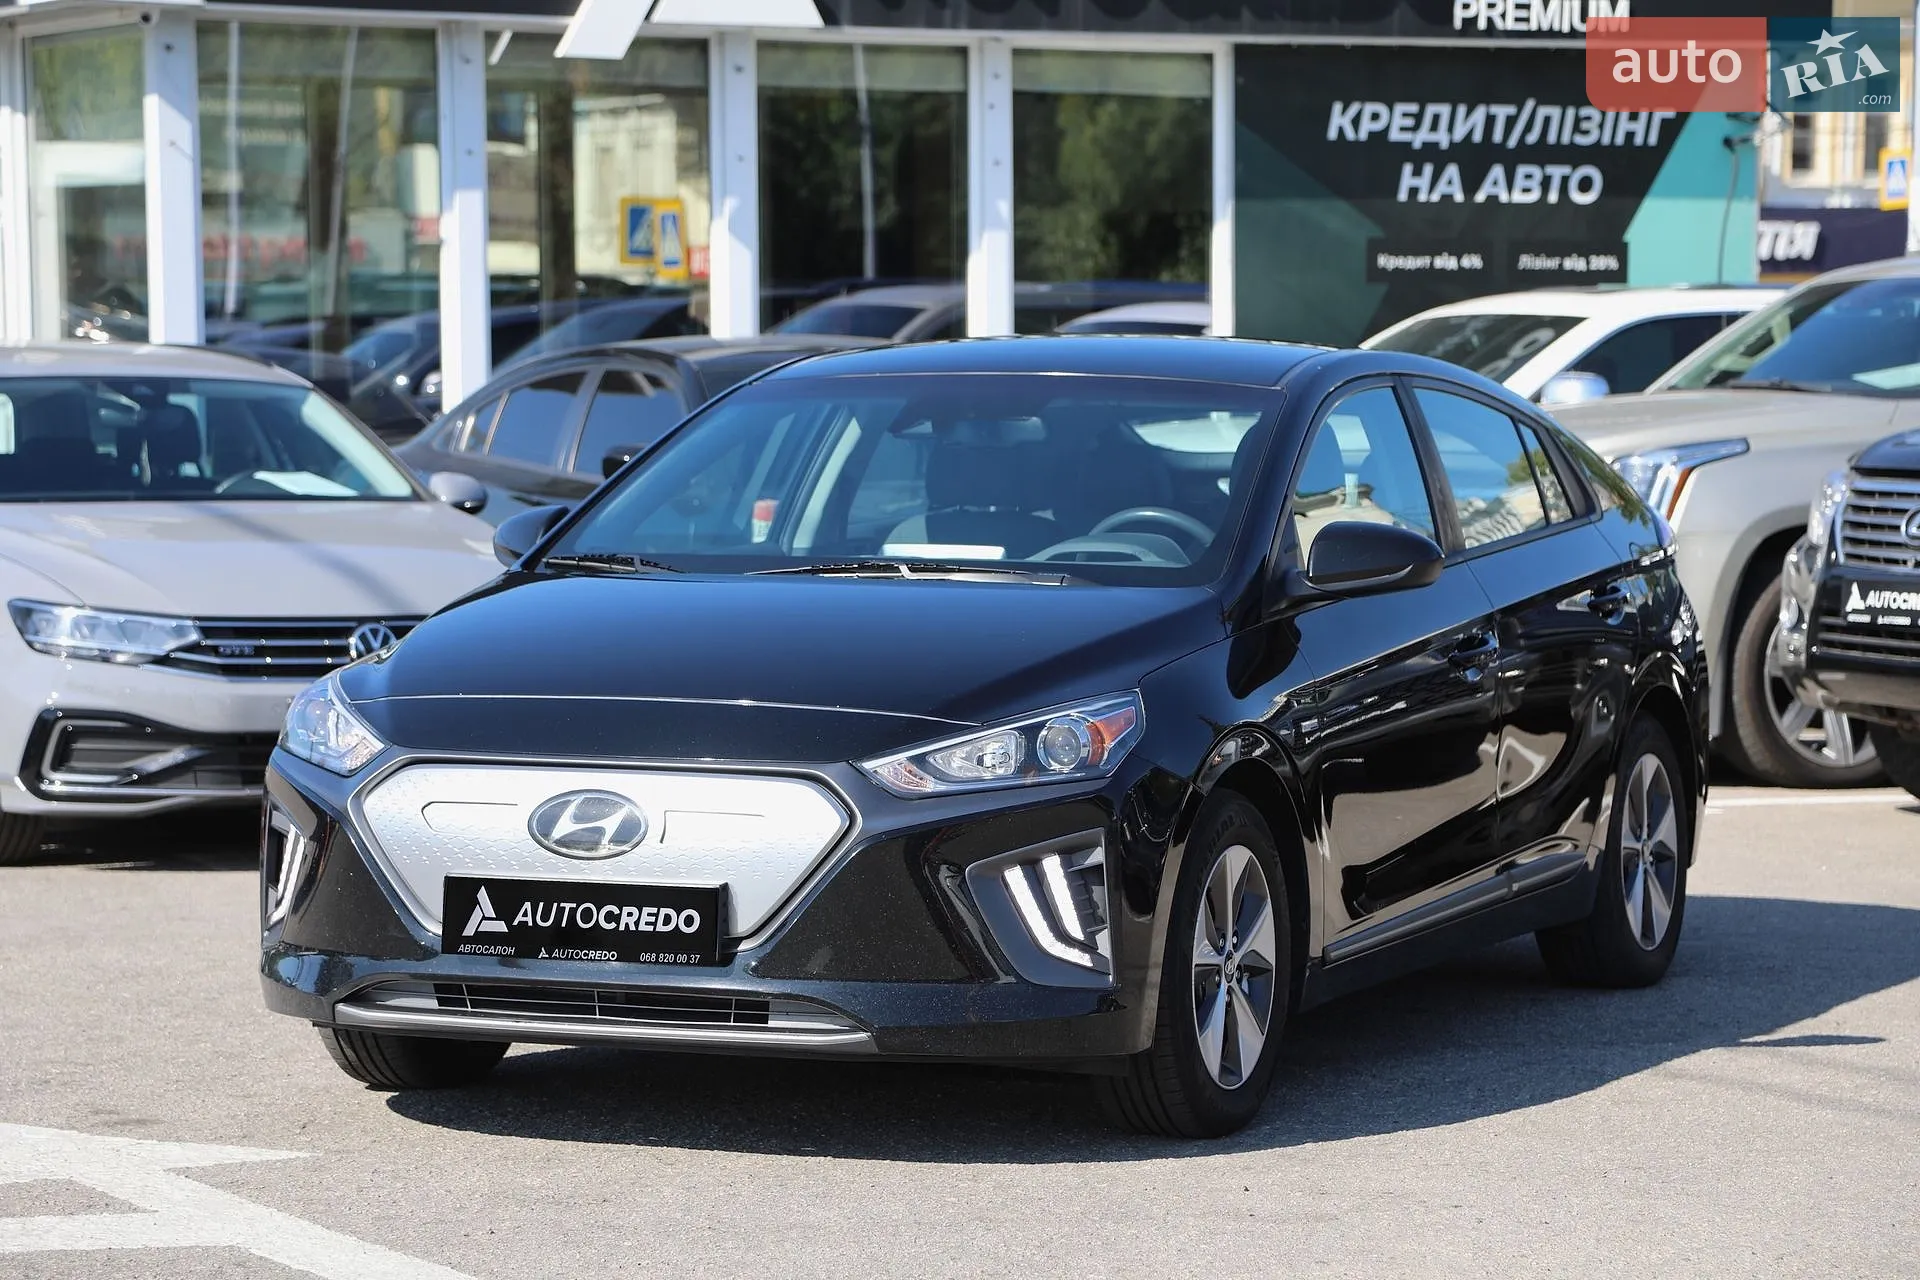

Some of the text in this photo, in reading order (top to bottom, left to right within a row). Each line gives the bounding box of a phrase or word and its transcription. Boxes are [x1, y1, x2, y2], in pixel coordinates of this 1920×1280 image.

[1453, 0, 1631, 33] PREMIUM
[1326, 97, 1677, 150] КРЕДИТ/ЛІЗІНГ
[1396, 161, 1605, 206] НА АВТО
[511, 901, 701, 935] AUTOCREDO
[457, 943, 516, 956] АВТОСАЛОН
[551, 948, 618, 961] AUTOCREDO
[639, 952, 701, 964] 068 820 00 37
